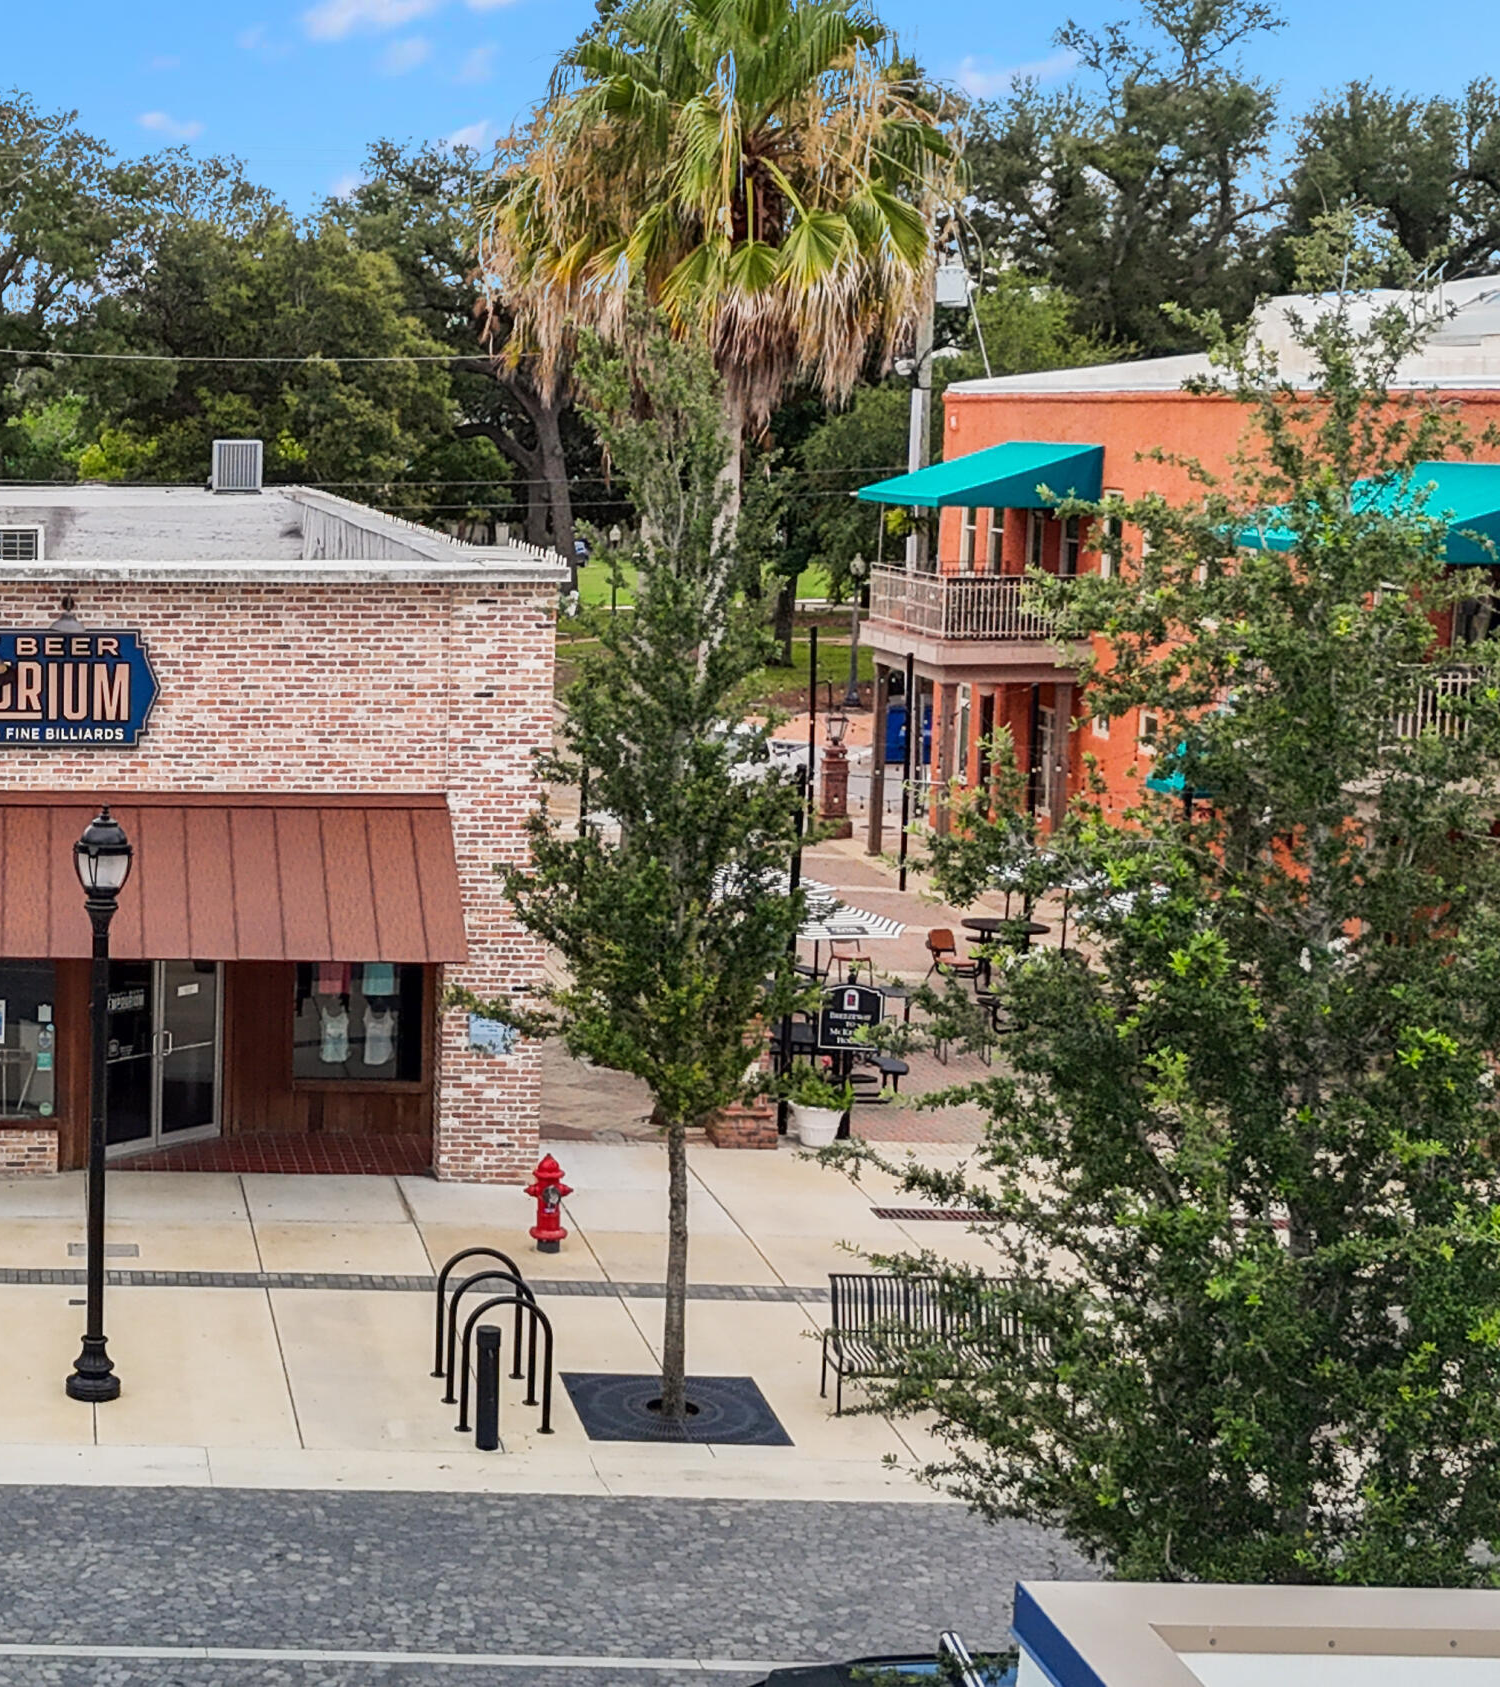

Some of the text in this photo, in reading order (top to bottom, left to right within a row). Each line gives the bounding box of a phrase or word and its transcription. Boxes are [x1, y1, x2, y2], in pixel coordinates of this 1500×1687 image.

[15, 637, 120, 656] BEER
[5, 727, 40, 741] FINE
[45, 727, 124, 741] BILLIARDS
